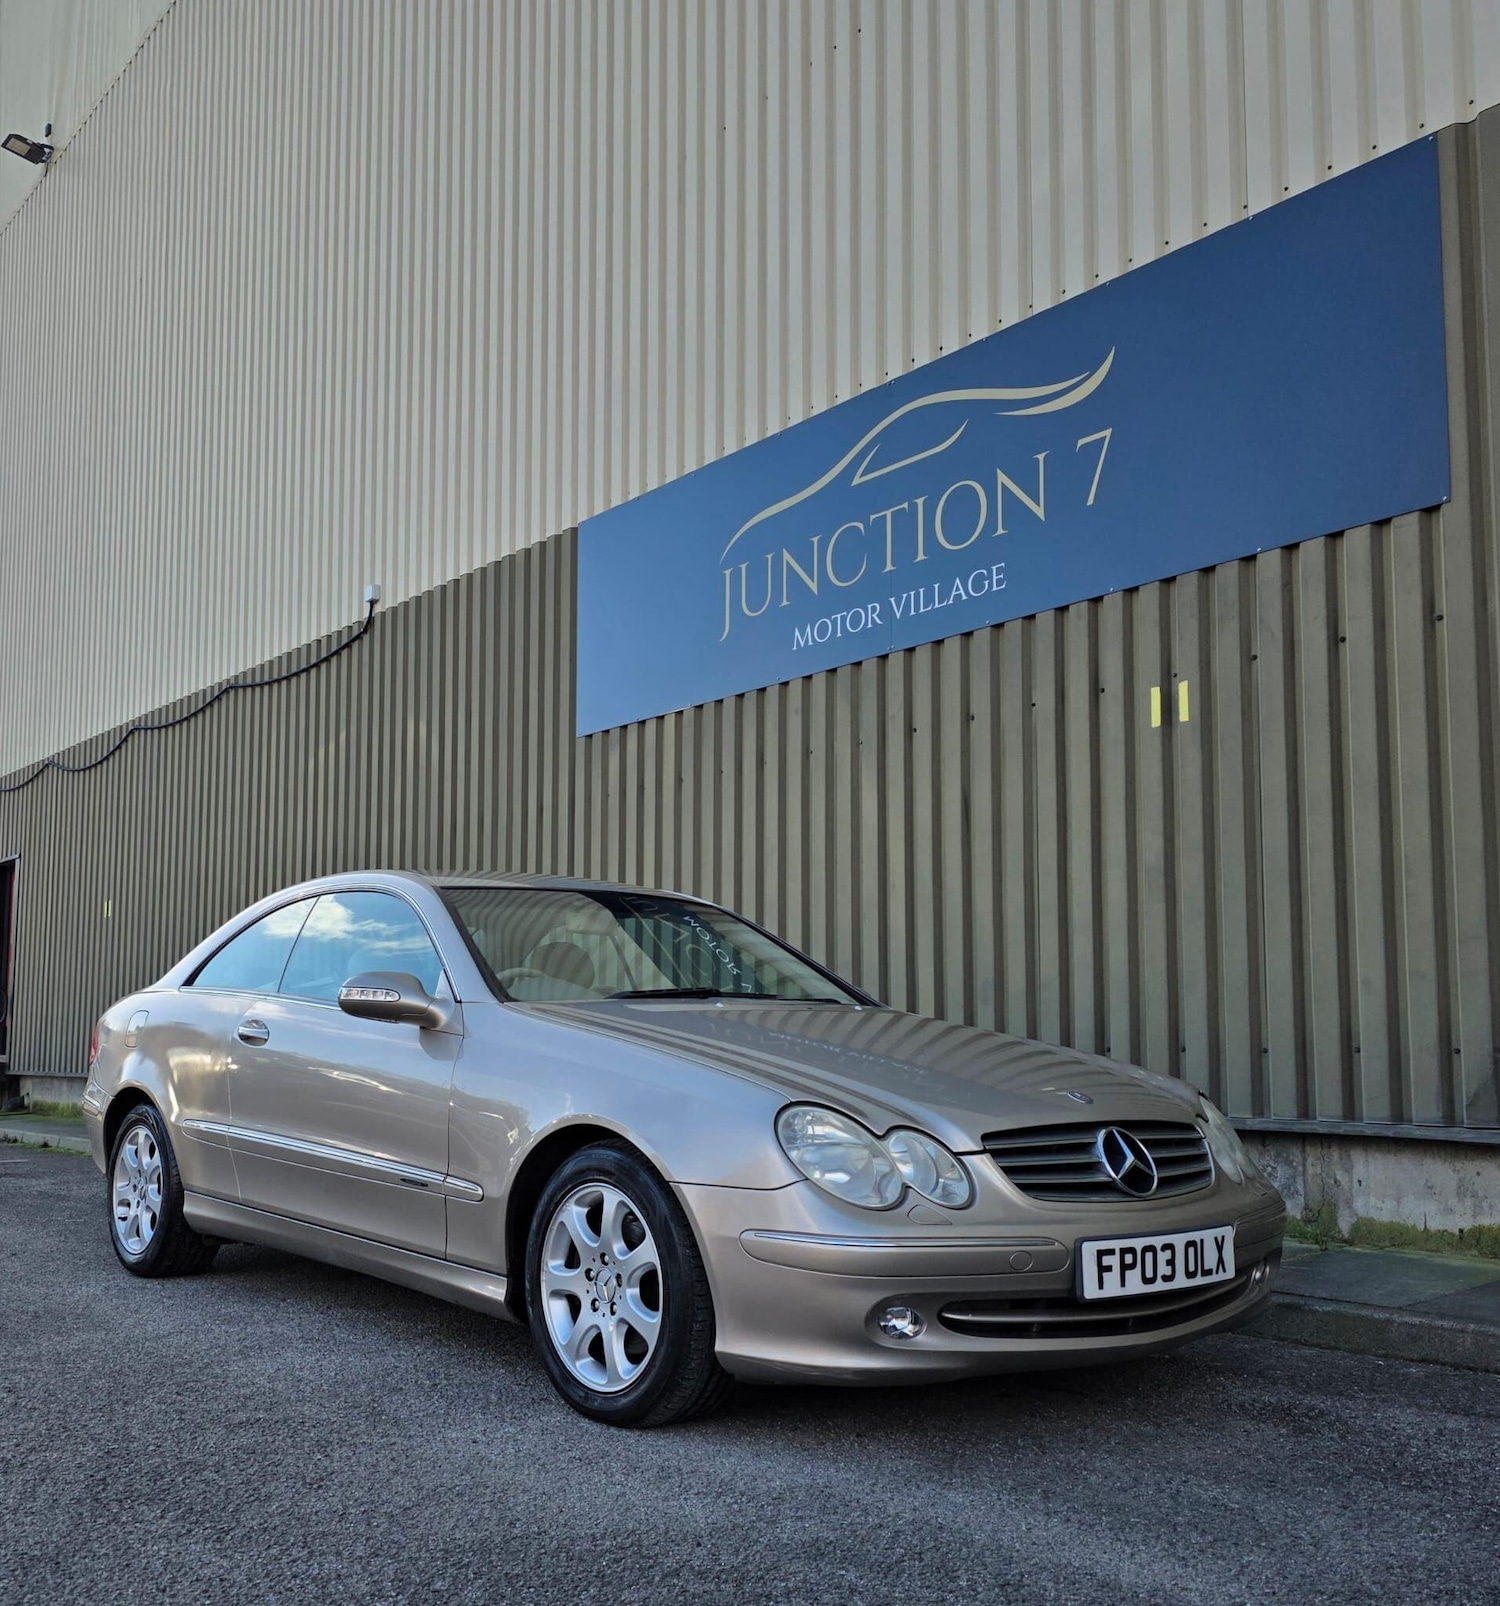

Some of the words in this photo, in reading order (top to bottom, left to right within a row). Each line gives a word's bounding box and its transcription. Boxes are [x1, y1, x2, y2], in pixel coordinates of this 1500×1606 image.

[720, 450, 1051, 642] JUNCTION
[1076, 427, 1113, 506] 7
[792, 602, 883, 651] MOTOR
[889, 562, 1007, 619] VILLAGE
[1096, 1243, 1176, 1290] FP03
